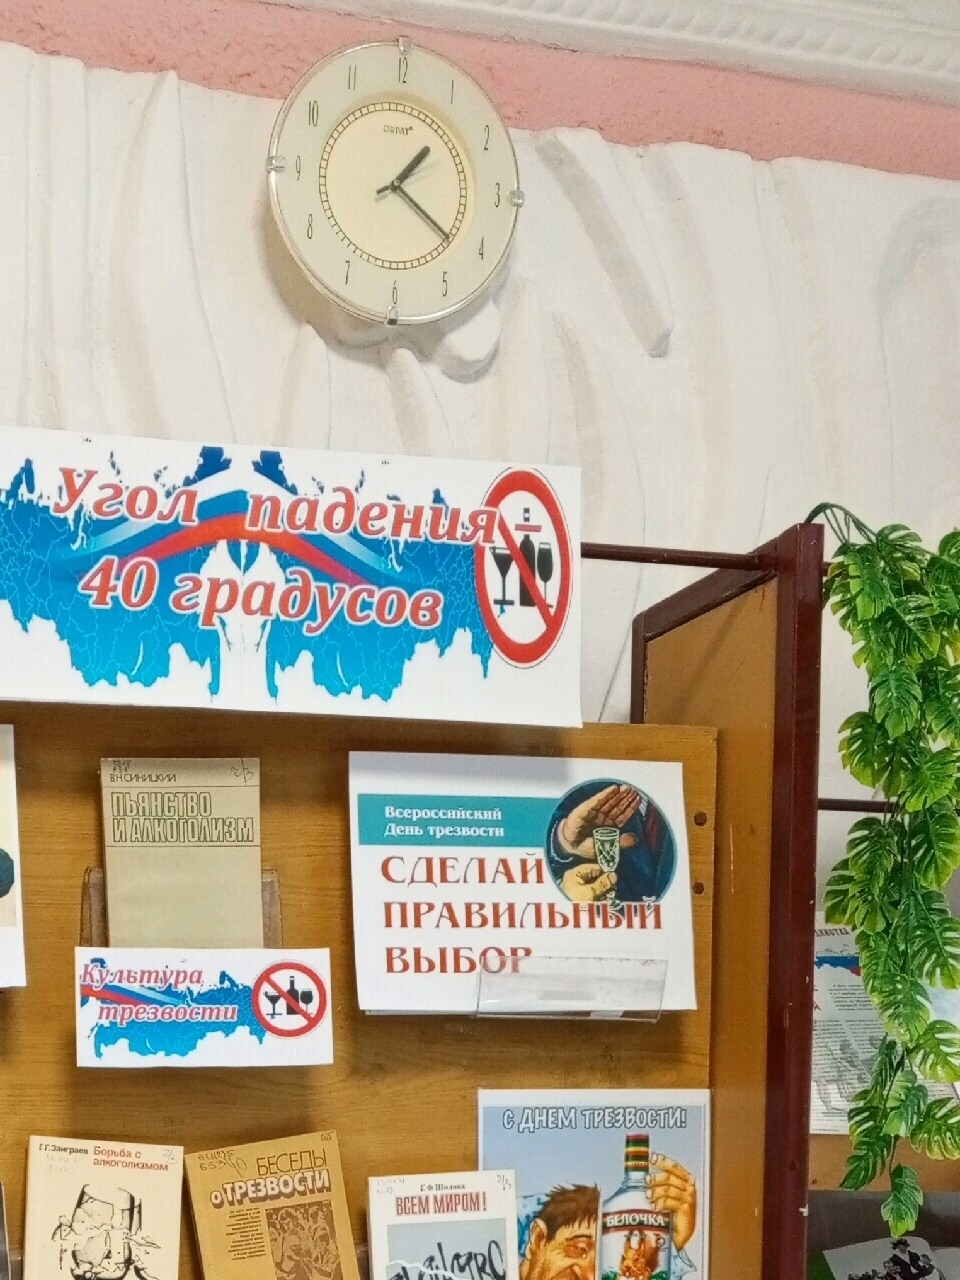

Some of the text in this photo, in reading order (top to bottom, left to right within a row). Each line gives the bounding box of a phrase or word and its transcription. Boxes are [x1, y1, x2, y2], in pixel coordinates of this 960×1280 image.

[348, 64, 357, 90] 11
[398, 57, 408, 83] 12
[308, 100, 319, 127] 10
[484, 124, 490, 151] 2
[296, 156, 301, 180] 9
[494, 182, 500, 208] 3
[306, 214, 313, 240] 8
[478, 236, 484, 260] 4
[345, 260, 350, 285] 7
[442, 272, 448, 296] 5
[392, 280, 398, 304] 6
[54, 467, 499, 544] Угол падения
[81, 557, 444, 633] 40 градусов
[111, 792, 212, 817] ПЬЯНСТВО
[385, 806, 501, 821] Всероссийский
[113, 817, 254, 843] И АЛКОГОЛИЗМ
[384, 823, 504, 838] День трезвости
[381, 852, 545, 888] СДЕЛАЙ
[384, 896, 662, 930] ПРАВИЛЬНЫЙ
[385, 946, 532, 974] ВЫБОР
[81, 965, 203, 986] Культура
[98, 1004, 238, 1023] трезвости
[503, 1108, 687, 1133] С ДНЕМ ТРЕЗВОСТИ!
[93, 1146, 131, 1159] Борьба
[93, 1158, 168, 1171] алкоголизмом
[256, 1150, 328, 1176] БЕСЕДЫ
[222, 1168, 332, 1201] ТРЕЗВОСТИ
[395, 1192, 487, 1216] ВСЕМ МИРОМ!
[606, 1212, 665, 1227] БЕЛОЧКА
